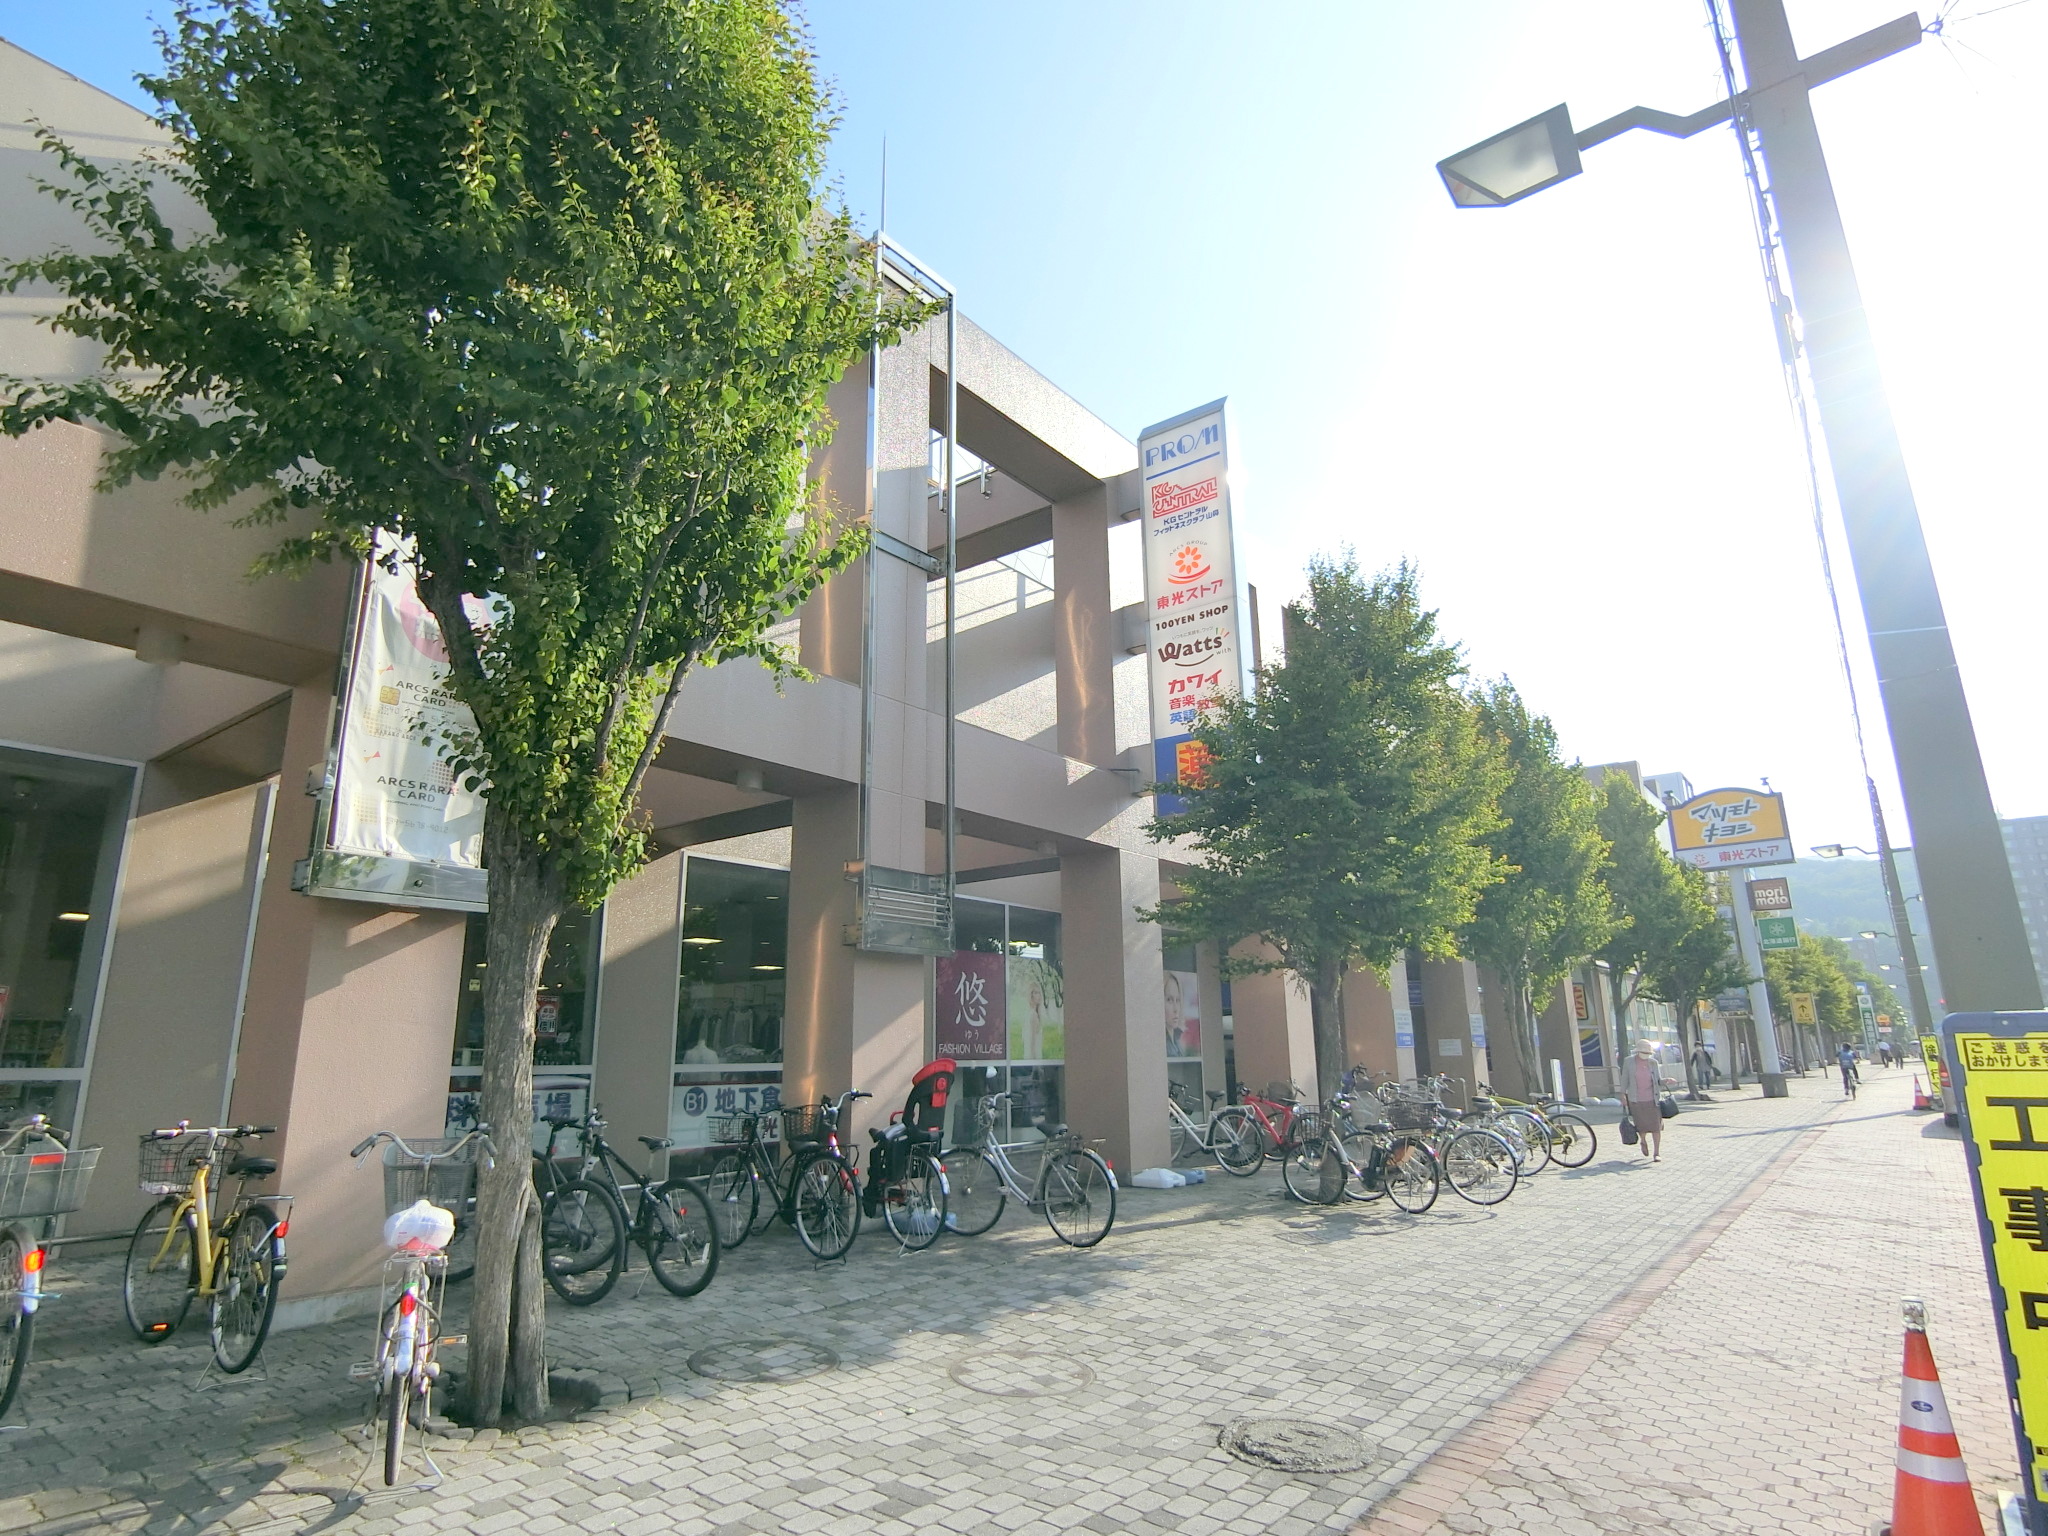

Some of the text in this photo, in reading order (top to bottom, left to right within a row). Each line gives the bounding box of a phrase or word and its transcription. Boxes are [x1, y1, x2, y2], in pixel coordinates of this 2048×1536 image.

[1157, 578, 1223, 610] 東光ストア
[1155, 604, 1229, 631] 100YEN SHOP
[1158, 635, 1223, 662] Watts
[1215, 646, 1232, 656] with
[396, 680, 457, 700] ARCS RAR
[1168, 669, 1222, 694] カワイ
[413, 693, 446, 707] CARD
[377, 775, 455, 796] ARCS RARA
[398, 789, 435, 803] CARD
[1691, 798, 1757, 821] マツモト
[1704, 823, 1752, 842] キヨシ
[1718, 845, 1779, 862] 東光ストア
[1754, 886, 1784, 900] mori
[1756, 896, 1789, 906] moto
[954, 970, 989, 1027] 悠
[964, 1029, 980, 1040] ゆう
[938, 1043, 1003, 1054] FASHION VILLAGE
[685, 1093, 705, 1111] B1
